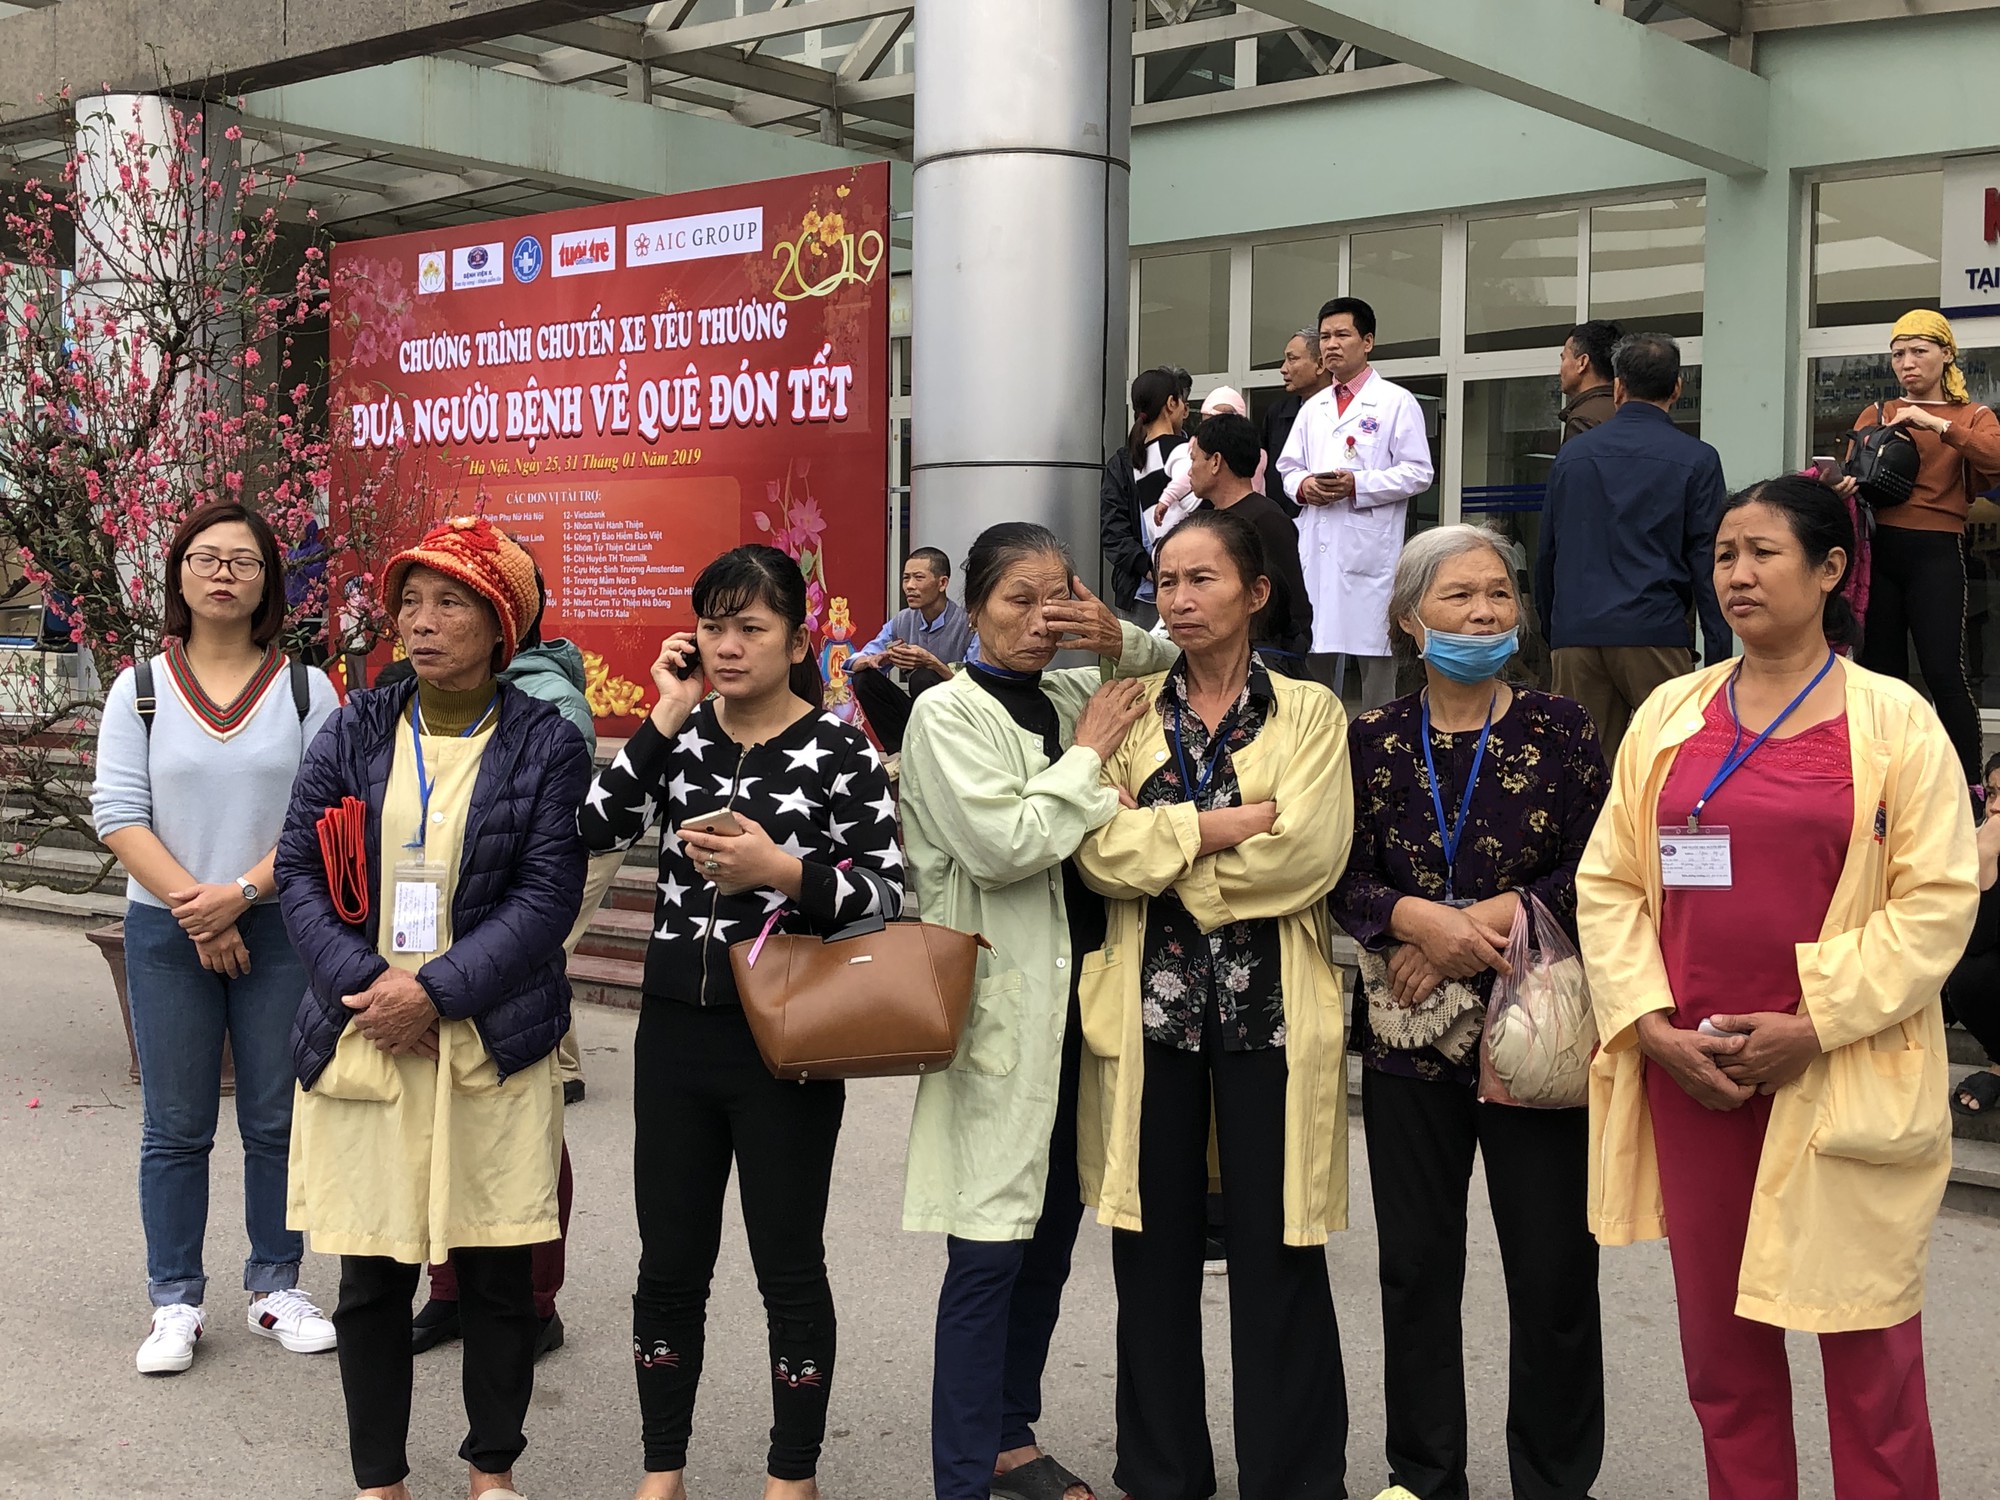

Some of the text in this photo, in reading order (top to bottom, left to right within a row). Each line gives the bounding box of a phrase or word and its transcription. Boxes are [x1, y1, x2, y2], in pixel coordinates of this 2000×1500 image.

[655, 221, 758, 251] AIC GROUP
[558, 236, 610, 267] tuổi trẻ
[772, 230, 884, 301] 2019
[399, 297, 788, 374] CHƯƠNG TRÌNH CHUYẾN XE YÊU THƯƠNG
[352, 342, 853, 450] ĐƯA NGƯỜI BỆNH VỀ QUÊ ĐÓN TẾT
[468, 447, 702, 479] Hà Nội, Ngày 25, 31 Tháng 01 Năm 2019
[505, 488, 602, 506] CÁC ĐƠN VỊ TÀI TRỢ:
[563, 510, 606, 519] 12- Vietabank
[563, 522, 573, 530] 13-
[574, 522, 593, 530] Nhóm
[594, 521, 605, 530] Vui
[625, 520, 644, 530] Thiện
[530, 534, 544, 542] Linh
[563, 533, 573, 541] 14-
[574, 532, 591, 542] Công
[593, 532, 600, 542] Ty
[649, 530, 663, 541] Việt
[562, 544, 573, 552] 15-
[574, 544, 593, 552] Nhóm
[594, 543, 604, 552] Từ
[605, 543, 623, 552] Thiện
[637, 542, 653, 551] Linh
[562, 555, 573, 563] 16-
[574, 555, 585, 564] Chị
[608, 554, 618, 562] TH
[619, 554, 648, 562] Truemilk
[562, 566, 573, 574] 17-
[574, 566, 588, 575] Cựu
[589, 565, 602, 575] Học
[603, 565, 619, 573] Sinh
[645, 564, 685, 573] Amsterdam
[616, 576, 630, 584] Non
[631, 576, 637, 584] B
[562, 587, 573, 595] 19-
[588, 587, 598, 595] Từ
[599, 587, 618, 596] Thiện
[573, 598, 593, 606] Nhóm
[593, 598, 610, 606] Cơm
[611, 598, 621, 607] Từ
[622, 598, 641, 608] Thiện
[641, 598, 652, 607] Hà
[562, 609, 573, 617] 21-
[573, 609, 586, 619] Tập
[600, 609, 614, 617] CT5
[615, 609, 630, 617] Xala
